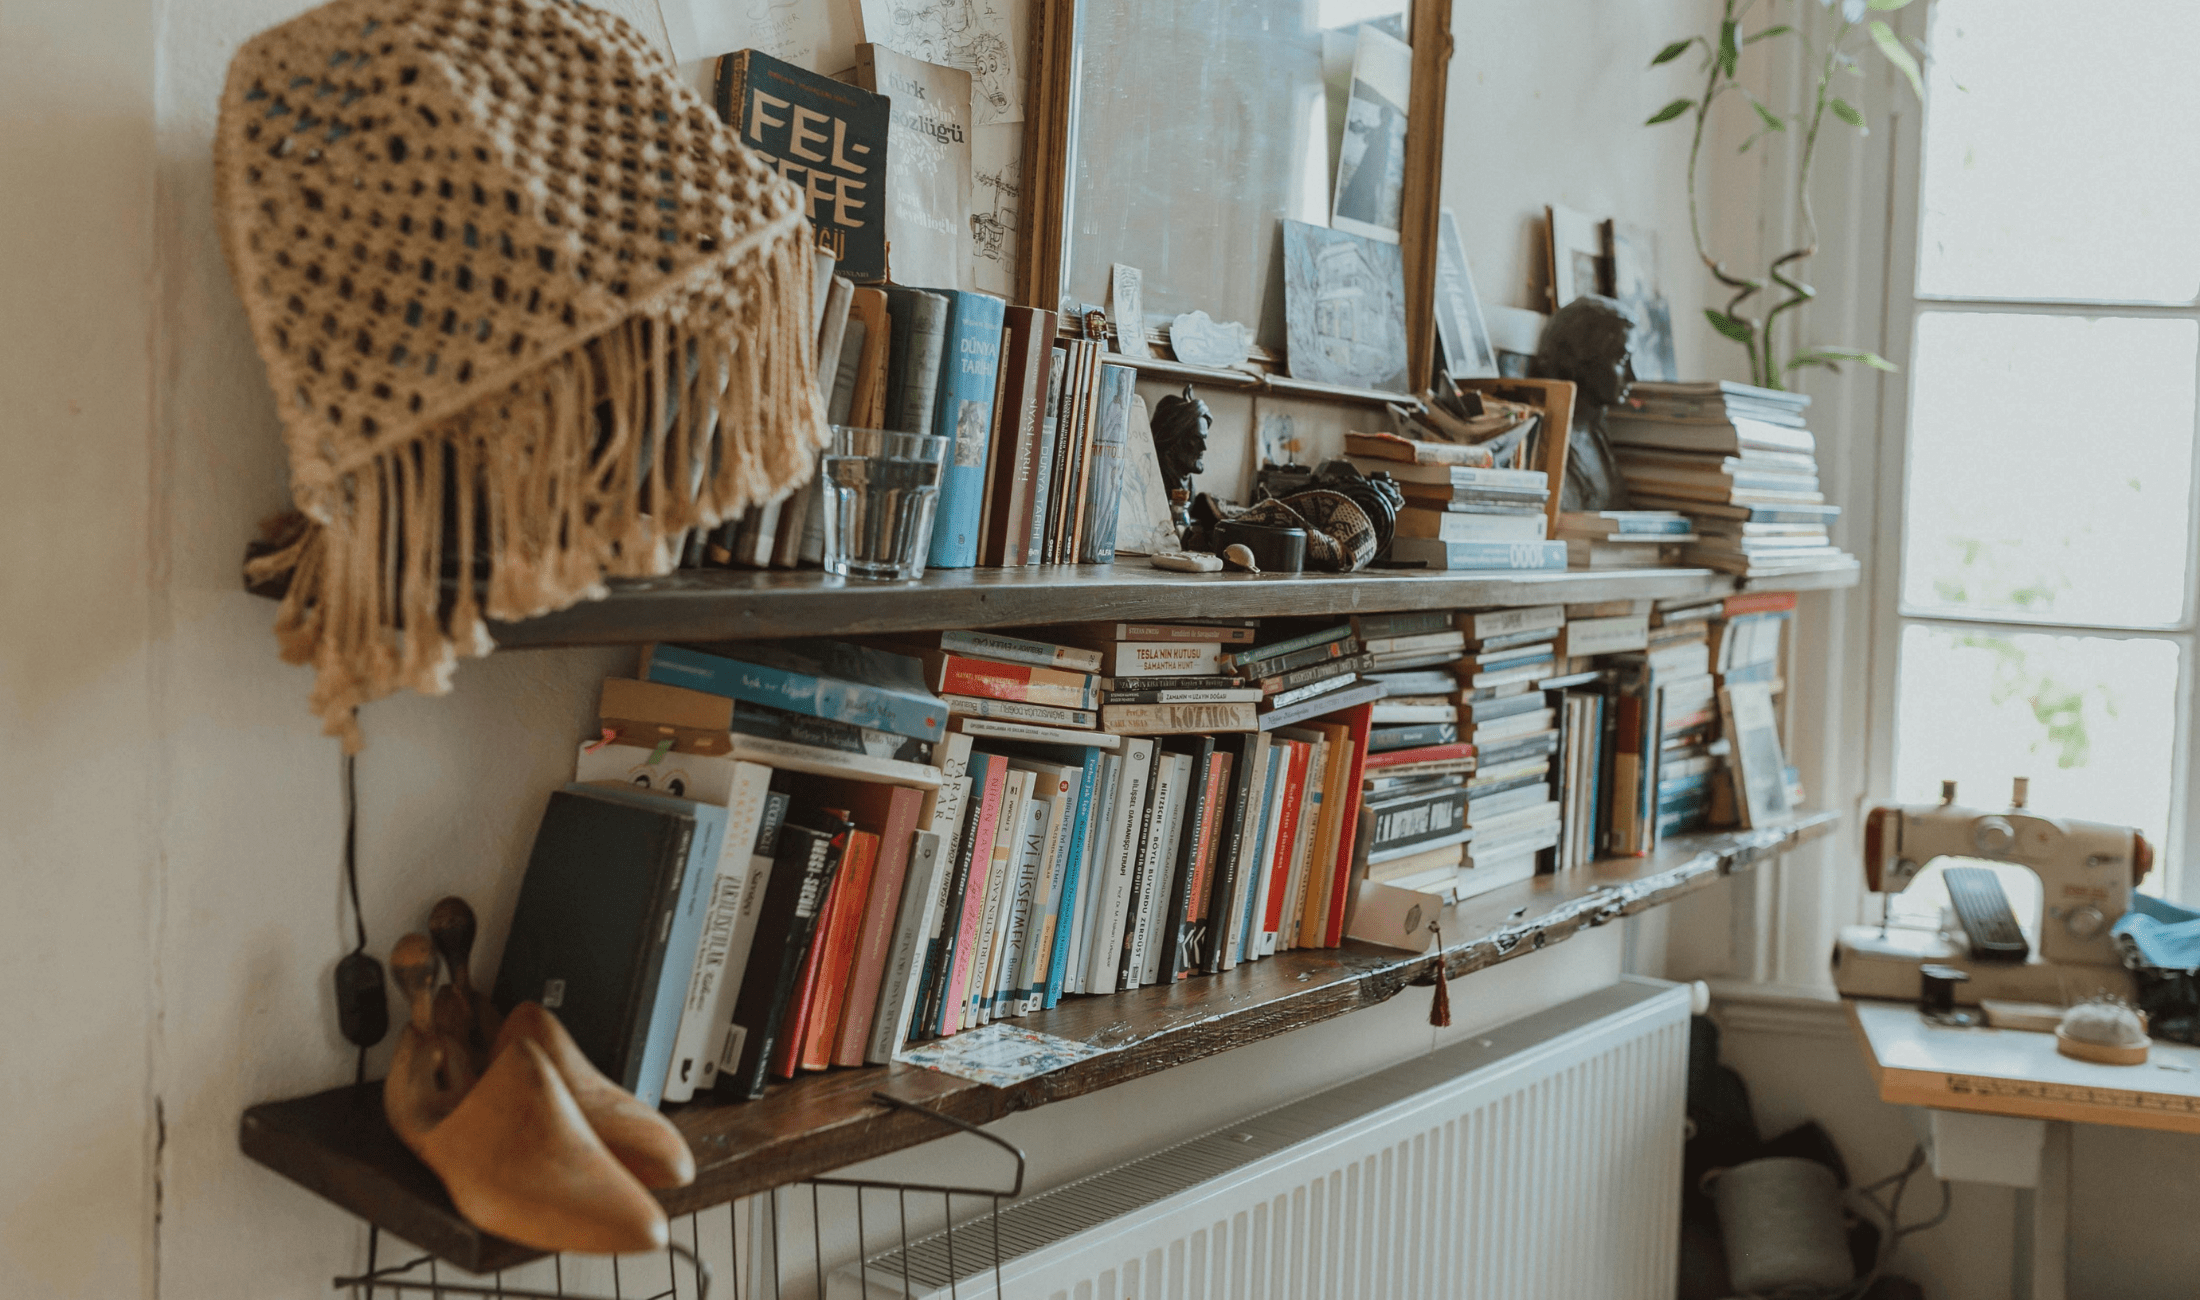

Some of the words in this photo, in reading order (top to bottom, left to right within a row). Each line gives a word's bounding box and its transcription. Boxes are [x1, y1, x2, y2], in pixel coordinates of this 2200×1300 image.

[750, 88, 870, 174] FEL-
[1143, 661, 1176, 670] SAMANTHA
[1177, 661, 1194, 670] HUNT
[1169, 706, 1241, 729] KOZMOS
[945, 760, 966, 821] YARATI
[1024, 833, 1043, 857] İYİ
[1148, 836, 1161, 865] BÖYLE
[1229, 832, 1240, 855] Patti
[1224, 856, 1237, 884] Smith
[1140, 868, 1155, 914] BUYURDU
